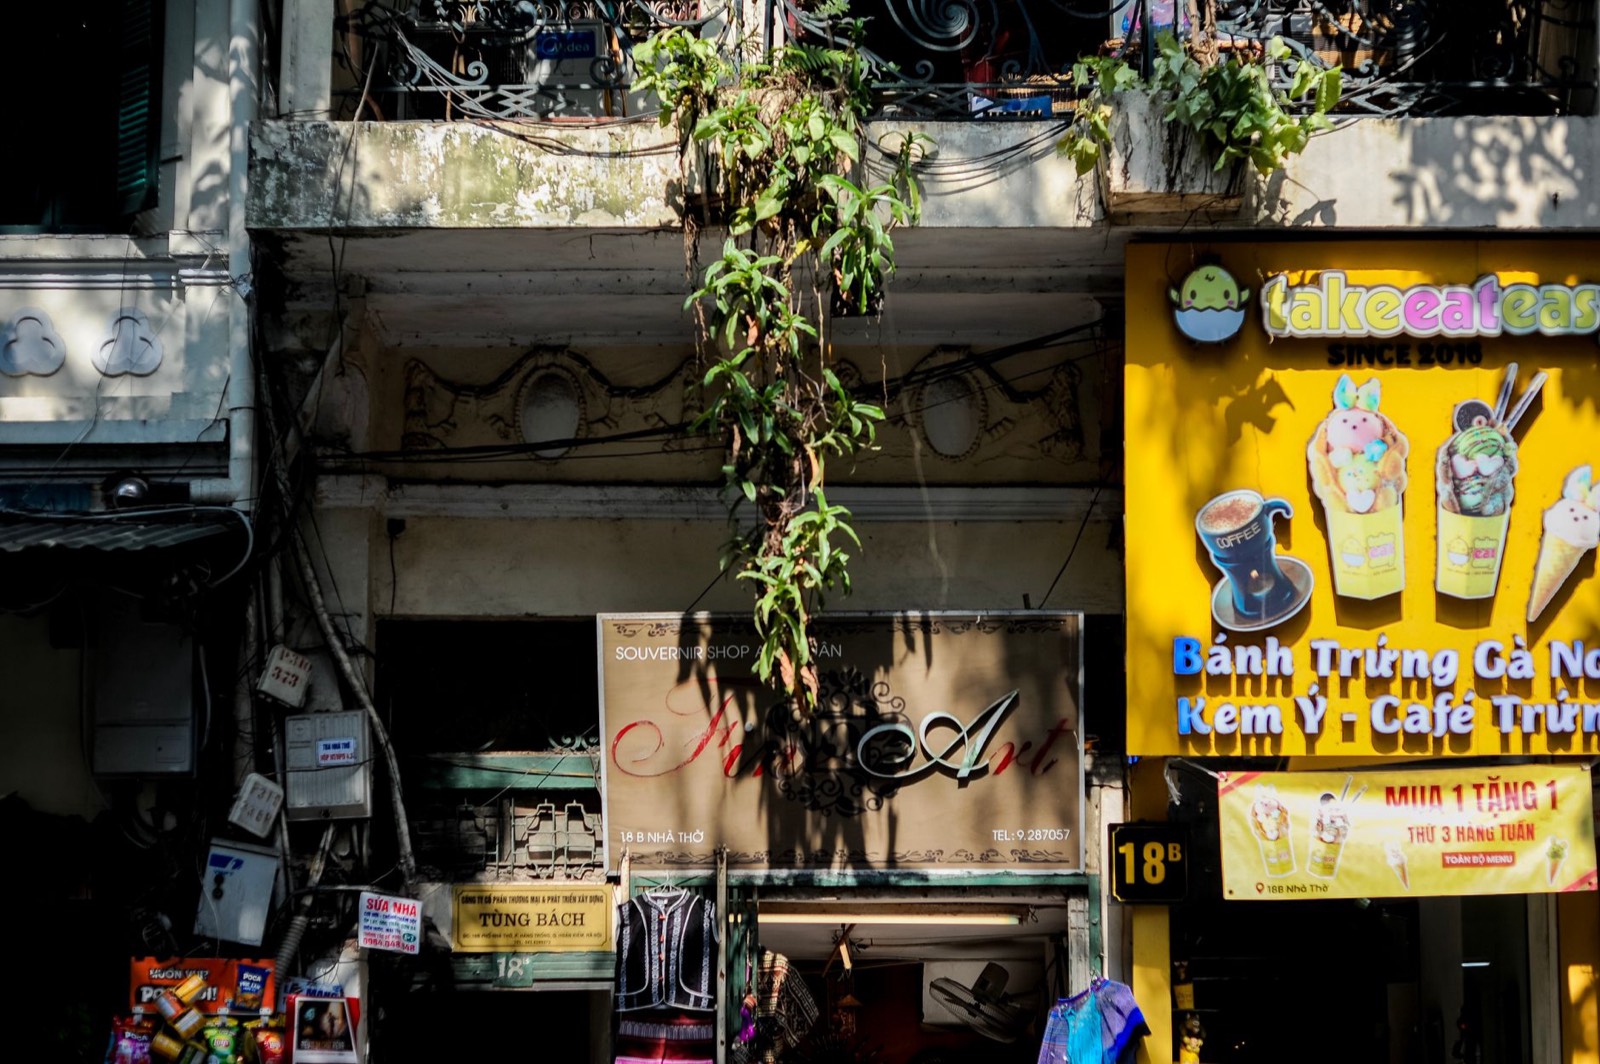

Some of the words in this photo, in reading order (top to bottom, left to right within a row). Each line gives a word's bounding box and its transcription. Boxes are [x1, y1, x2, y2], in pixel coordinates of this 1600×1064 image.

[1327, 343, 1410, 366] SINCE
[1417, 341, 1482, 365] 2016
[1216, 521, 1262, 549] COFFEE
[615, 645, 704, 662] SOUVERNIR
[707, 645, 750, 660] SHOP
[1173, 632, 1294, 676] Bánh
[1310, 633, 1459, 688] Trứng
[1473, 633, 1535, 679] Gà
[271, 666, 299, 687] 373
[1177, 696, 1283, 735] Kem
[1295, 683, 1327, 734] Ý
[1341, 711, 1358, 722] -
[1370, 688, 1475, 738] Café
[1385, 785, 1443, 812] MUA
[1452, 784, 1464, 812] 1
[1473, 775, 1538, 818] TẶNG
[1547, 779, 1558, 810] 1
[620, 831, 634, 843] 18
[636, 831, 644, 843] B
[647, 830, 675, 843] NHÀ
[1017, 829, 1071, 841] 9.287057
[1441, 826, 1452, 842] 3
[1455, 822, 1495, 843] HÀNG
[1118, 841, 1182, 885] 18B
[1486, 854, 1514, 864] MENU
[1267, 885, 1285, 894] 18B
[1286, 884, 1308, 893] Nhà
[366, 896, 389, 912] SỬA
[479, 908, 531, 927] TÙNG
[536, 908, 585, 927] BÁCH
